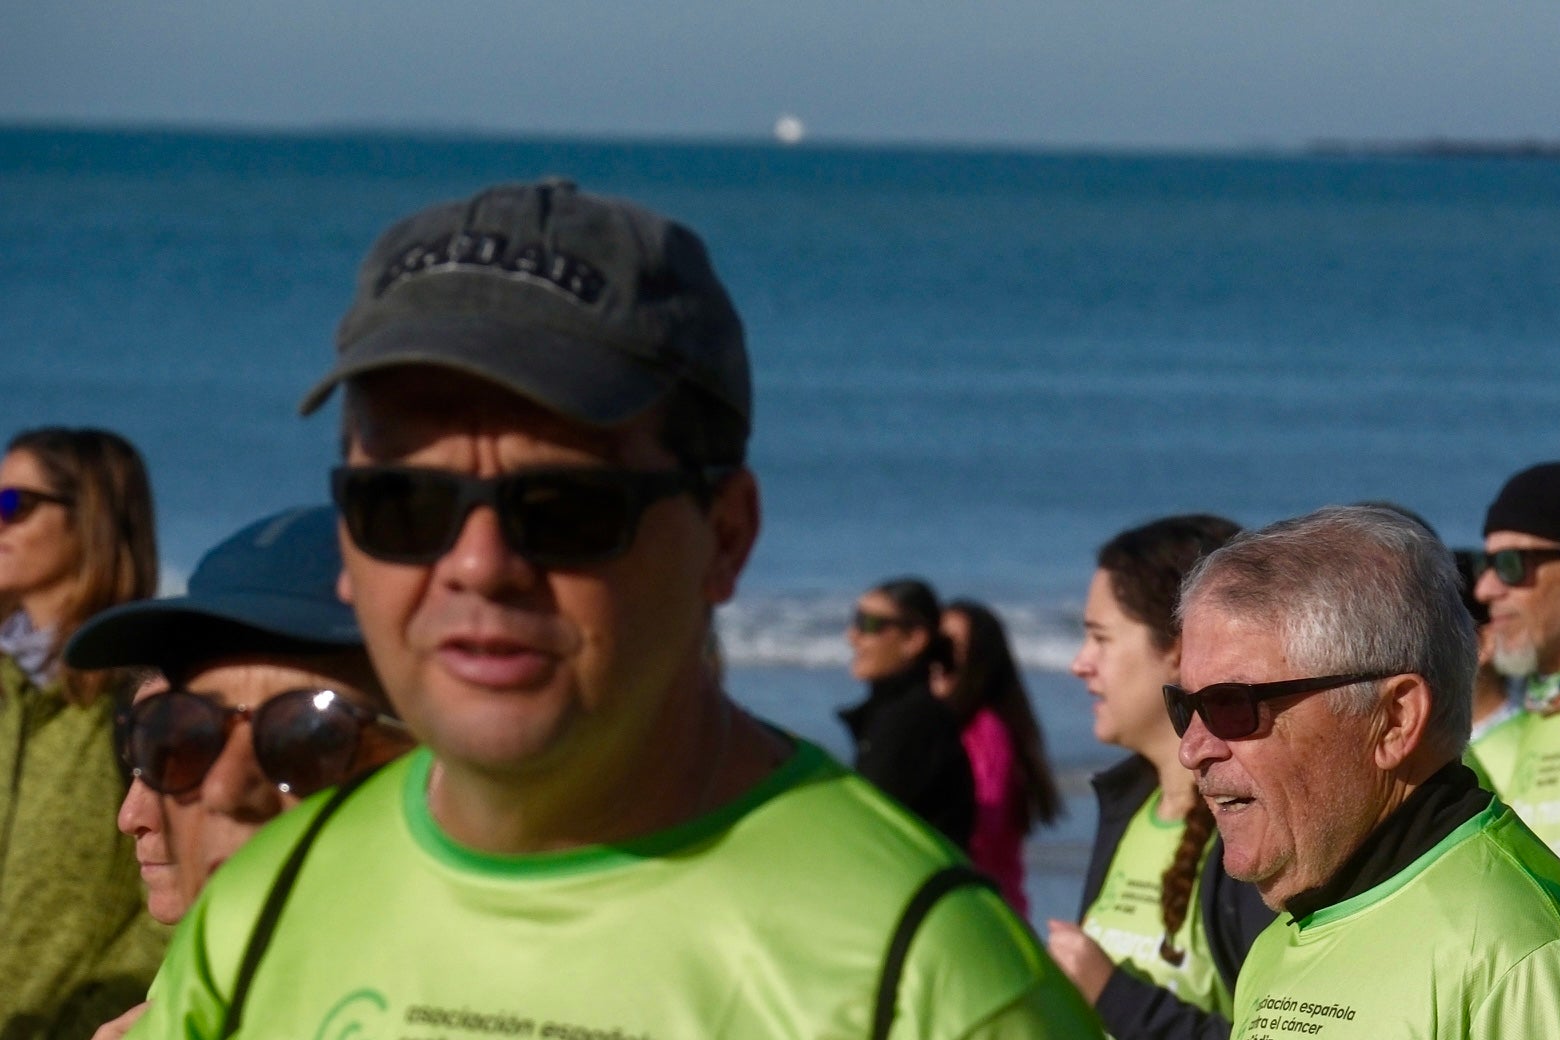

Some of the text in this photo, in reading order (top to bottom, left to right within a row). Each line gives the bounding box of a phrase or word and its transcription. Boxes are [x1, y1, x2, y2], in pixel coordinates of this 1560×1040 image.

[1299, 1001, 1357, 1022] española
[1269, 1015, 1280, 1030] el
[1281, 1016, 1324, 1036] cáncer
